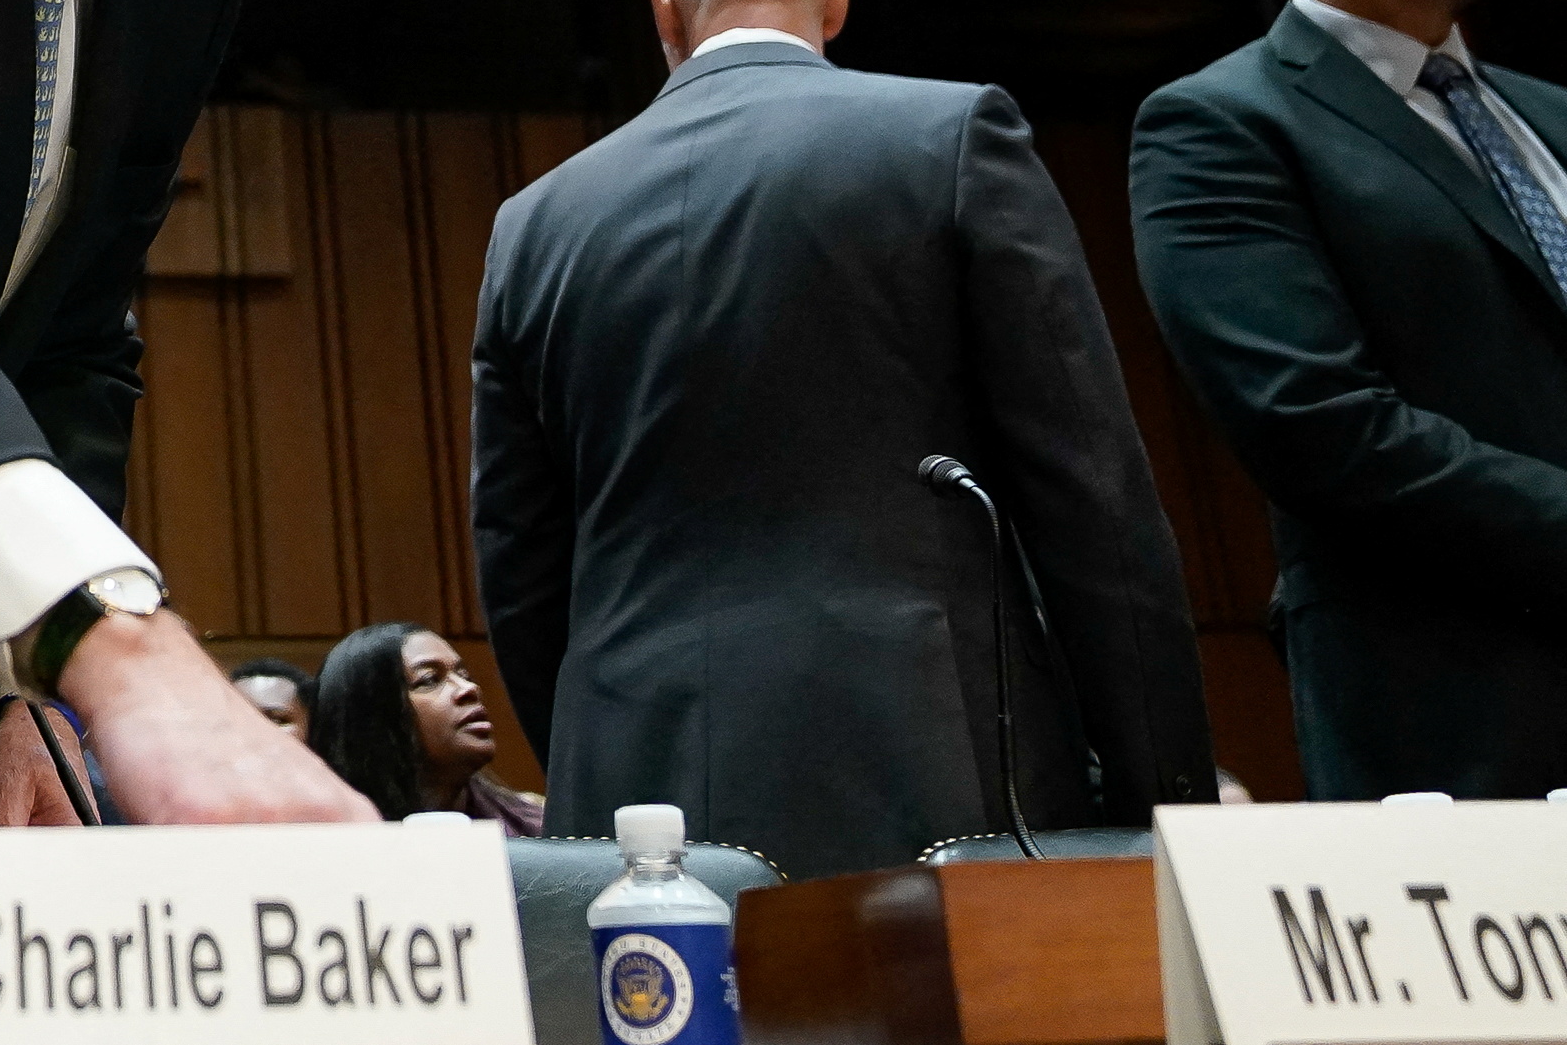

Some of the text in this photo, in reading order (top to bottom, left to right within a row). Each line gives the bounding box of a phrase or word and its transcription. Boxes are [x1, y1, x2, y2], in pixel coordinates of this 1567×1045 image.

[252, 897, 475, 1010] Baker
[1270, 882, 1567, 1005] Mr. Ton
